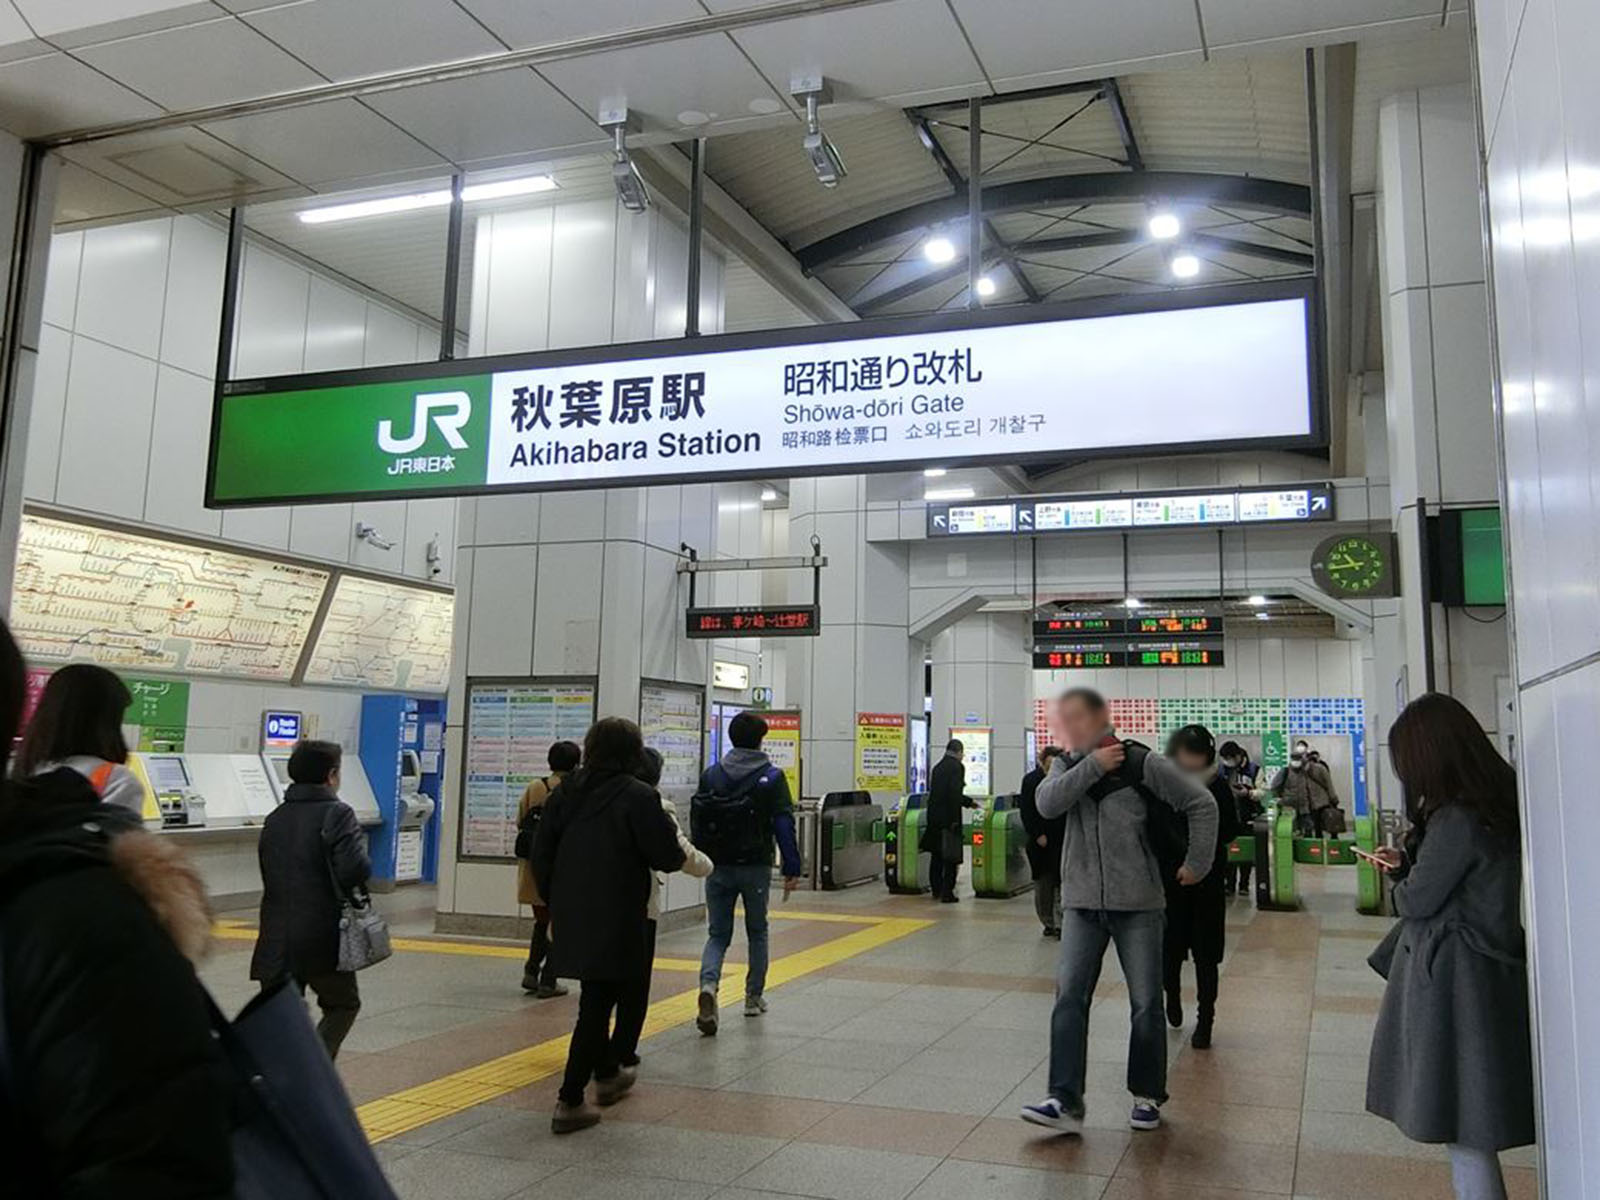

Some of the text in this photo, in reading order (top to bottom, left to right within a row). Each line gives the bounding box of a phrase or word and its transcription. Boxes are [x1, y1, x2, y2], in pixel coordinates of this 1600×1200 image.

[784, 347, 983, 397] 昭和通り改札
[511, 371, 706, 433] 秋葉原駅
[784, 394, 965, 424] Shōwa-dōri Gate
[377, 391, 471, 454] JR
[904, 413, 1047, 440] 쇼와도리 개찰구
[387, 455, 456, 476] JR東日本
[510, 430, 761, 468] Akihabara Station
